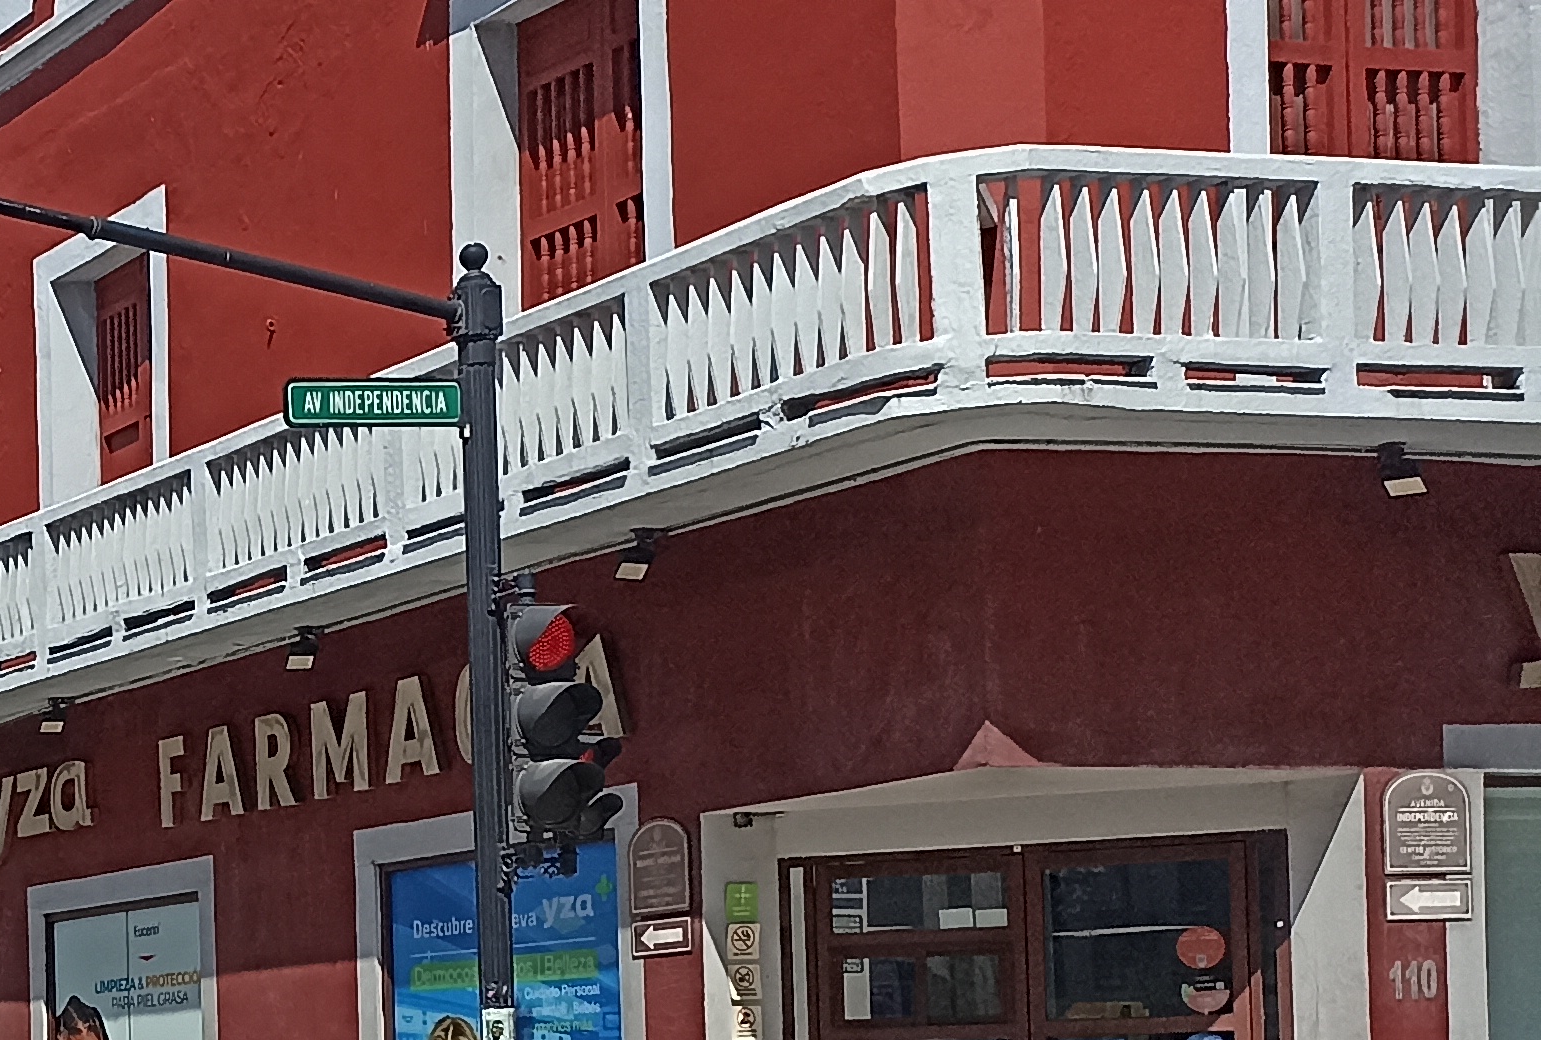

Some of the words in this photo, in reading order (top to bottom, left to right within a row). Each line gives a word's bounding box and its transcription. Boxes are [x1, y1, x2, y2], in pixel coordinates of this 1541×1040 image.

[304, 391, 322, 413] AV
[329, 390, 447, 414] INDEPENDENCIA
[157, 633, 624, 828] FARMAA
[413, 916, 473, 939] Descubre
[512, 912, 537, 929] eva
[542, 894, 594, 929] yza
[95, 977, 136, 994] LIMPIEZA
[146, 968, 201, 988] PROTECCIÓ
[1389, 959, 1437, 999] 110
[112, 996, 135, 1009] PARA
[137, 993, 156, 1007] PIEL
[158, 990, 188, 1006] GRASA
